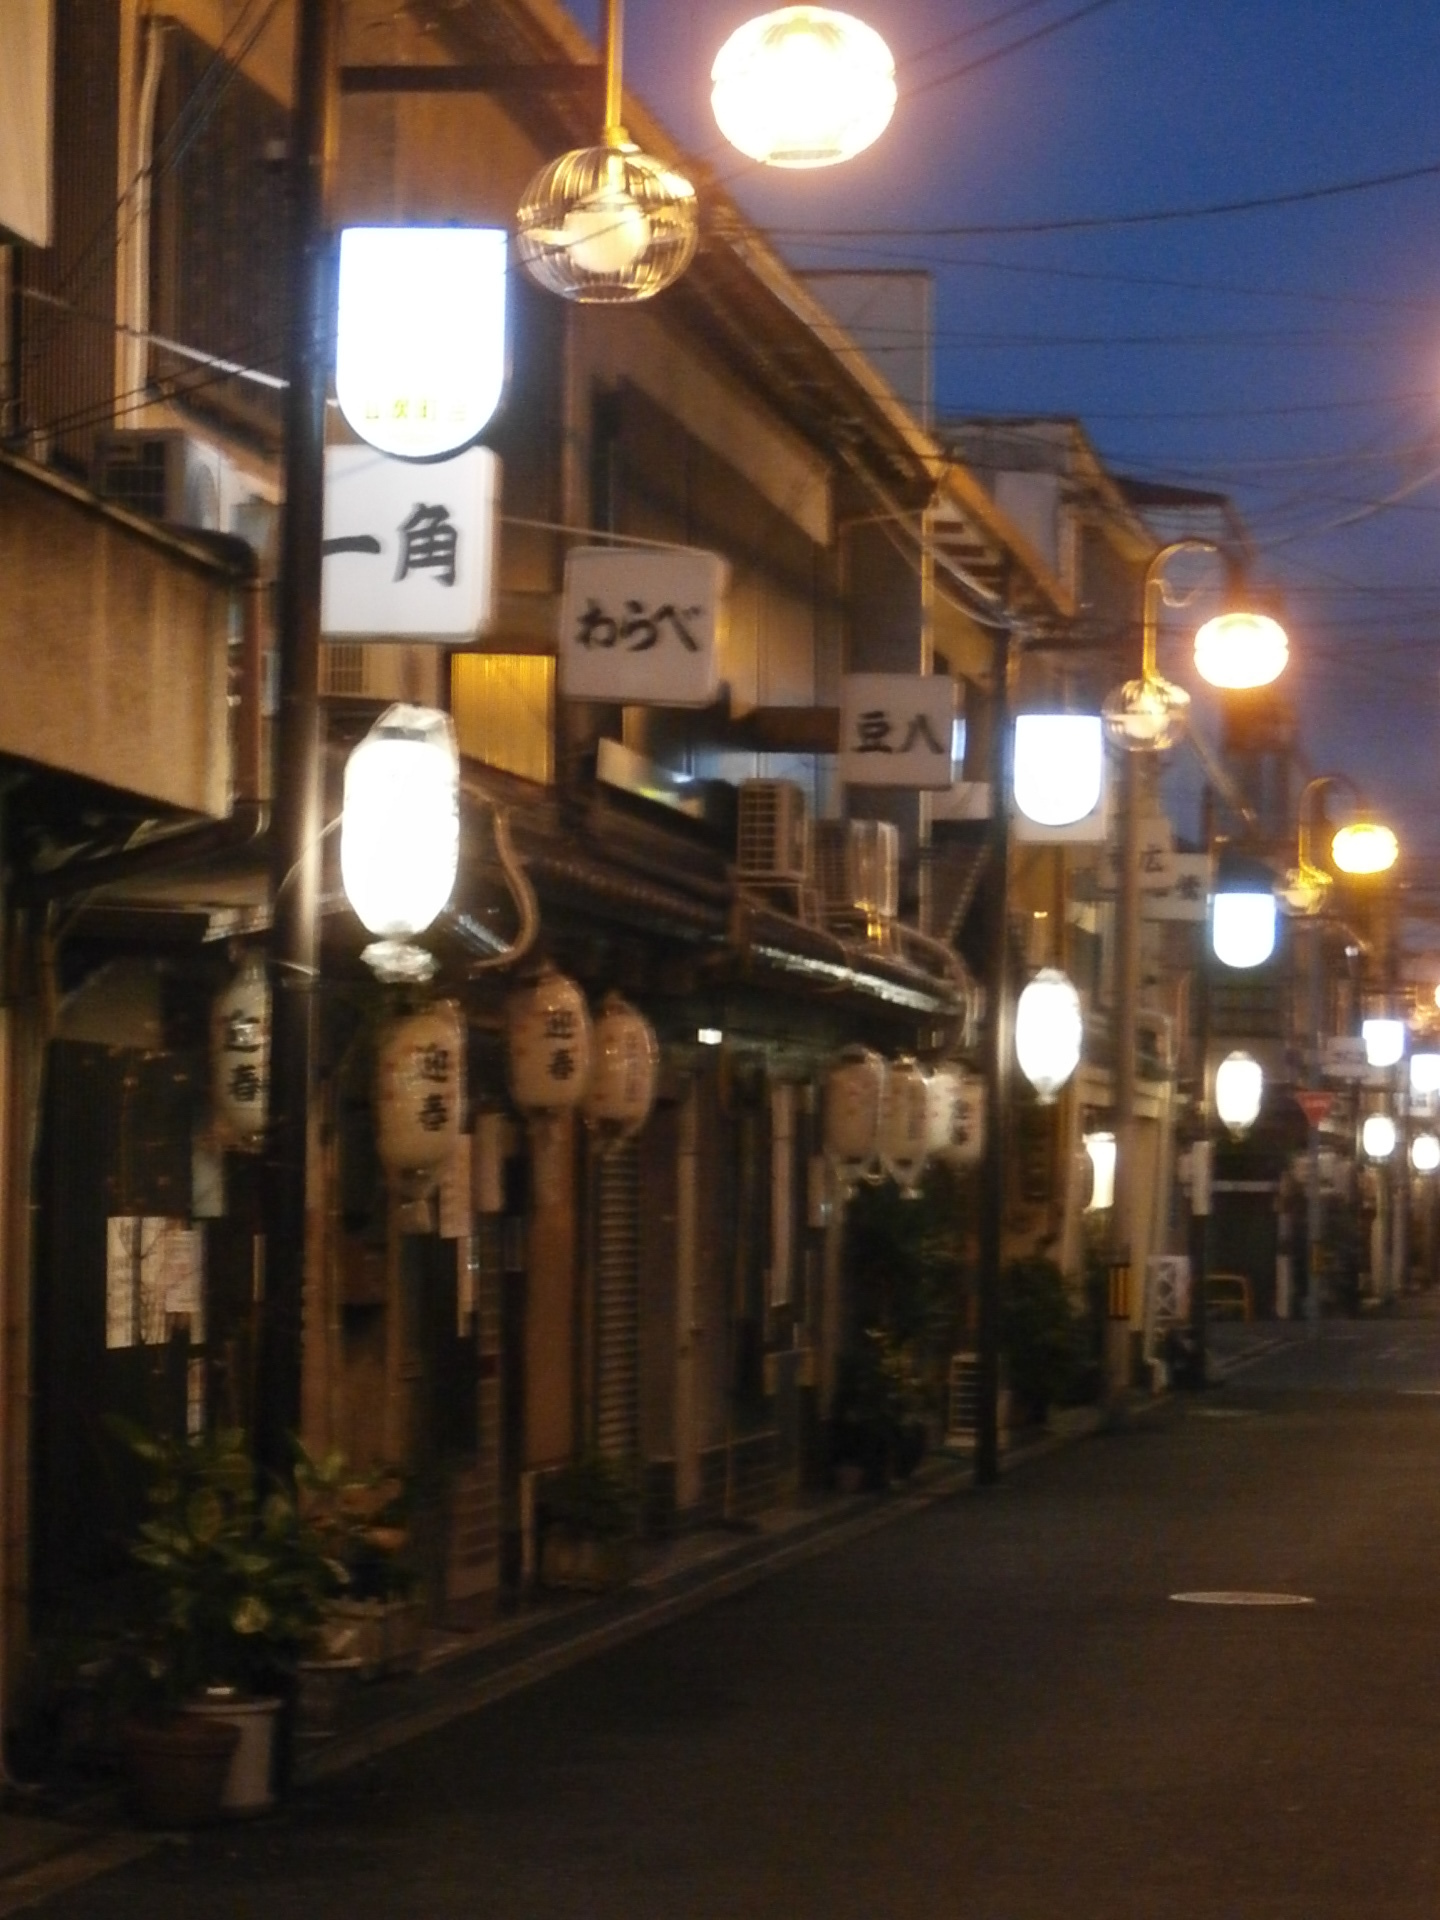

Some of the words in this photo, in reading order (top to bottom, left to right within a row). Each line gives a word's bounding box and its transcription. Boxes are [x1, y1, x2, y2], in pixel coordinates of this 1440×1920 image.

[322, 502, 459, 588] 一角
[575, 598, 702, 653] わらべ
[855, 710, 945, 754] 豆八
